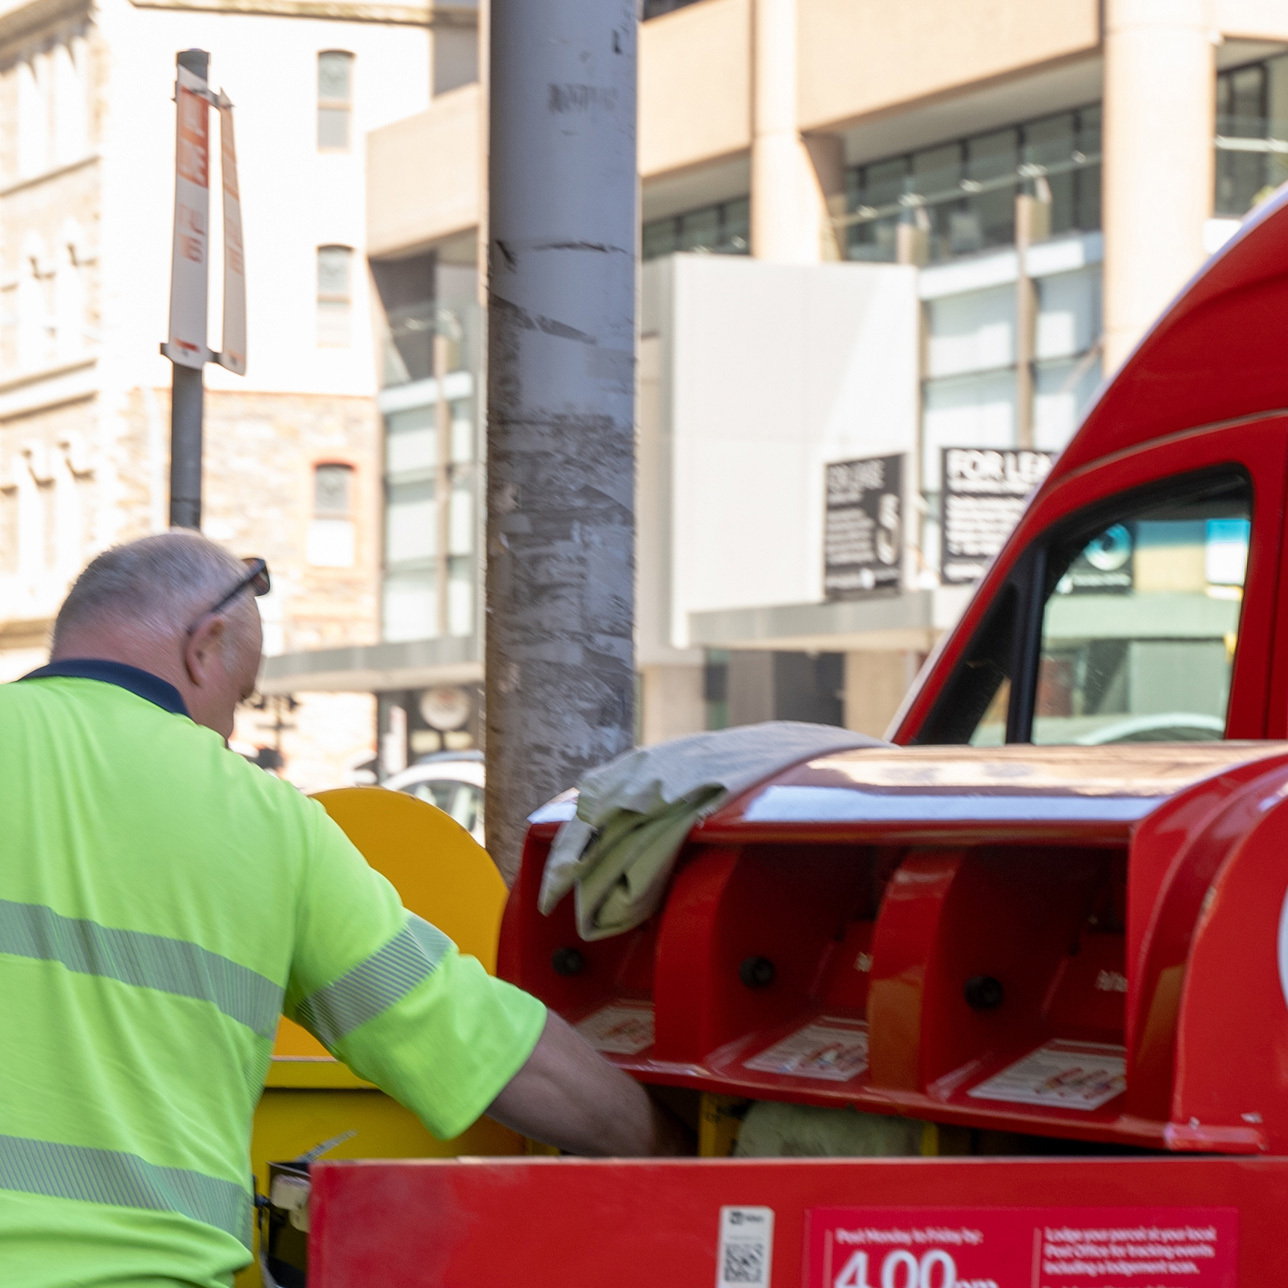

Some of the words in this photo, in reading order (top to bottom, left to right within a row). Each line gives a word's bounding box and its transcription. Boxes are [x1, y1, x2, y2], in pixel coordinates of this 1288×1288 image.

[945, 449, 1003, 480] FOR
[1010, 450, 1053, 482] LEA
[835, 1227, 864, 1244] Post
[865, 1227, 911, 1246] Monday
[926, 1226, 961, 1245] Friday
[1044, 1243, 1073, 1258] Post
[1073, 1243, 1109, 1258] Office
